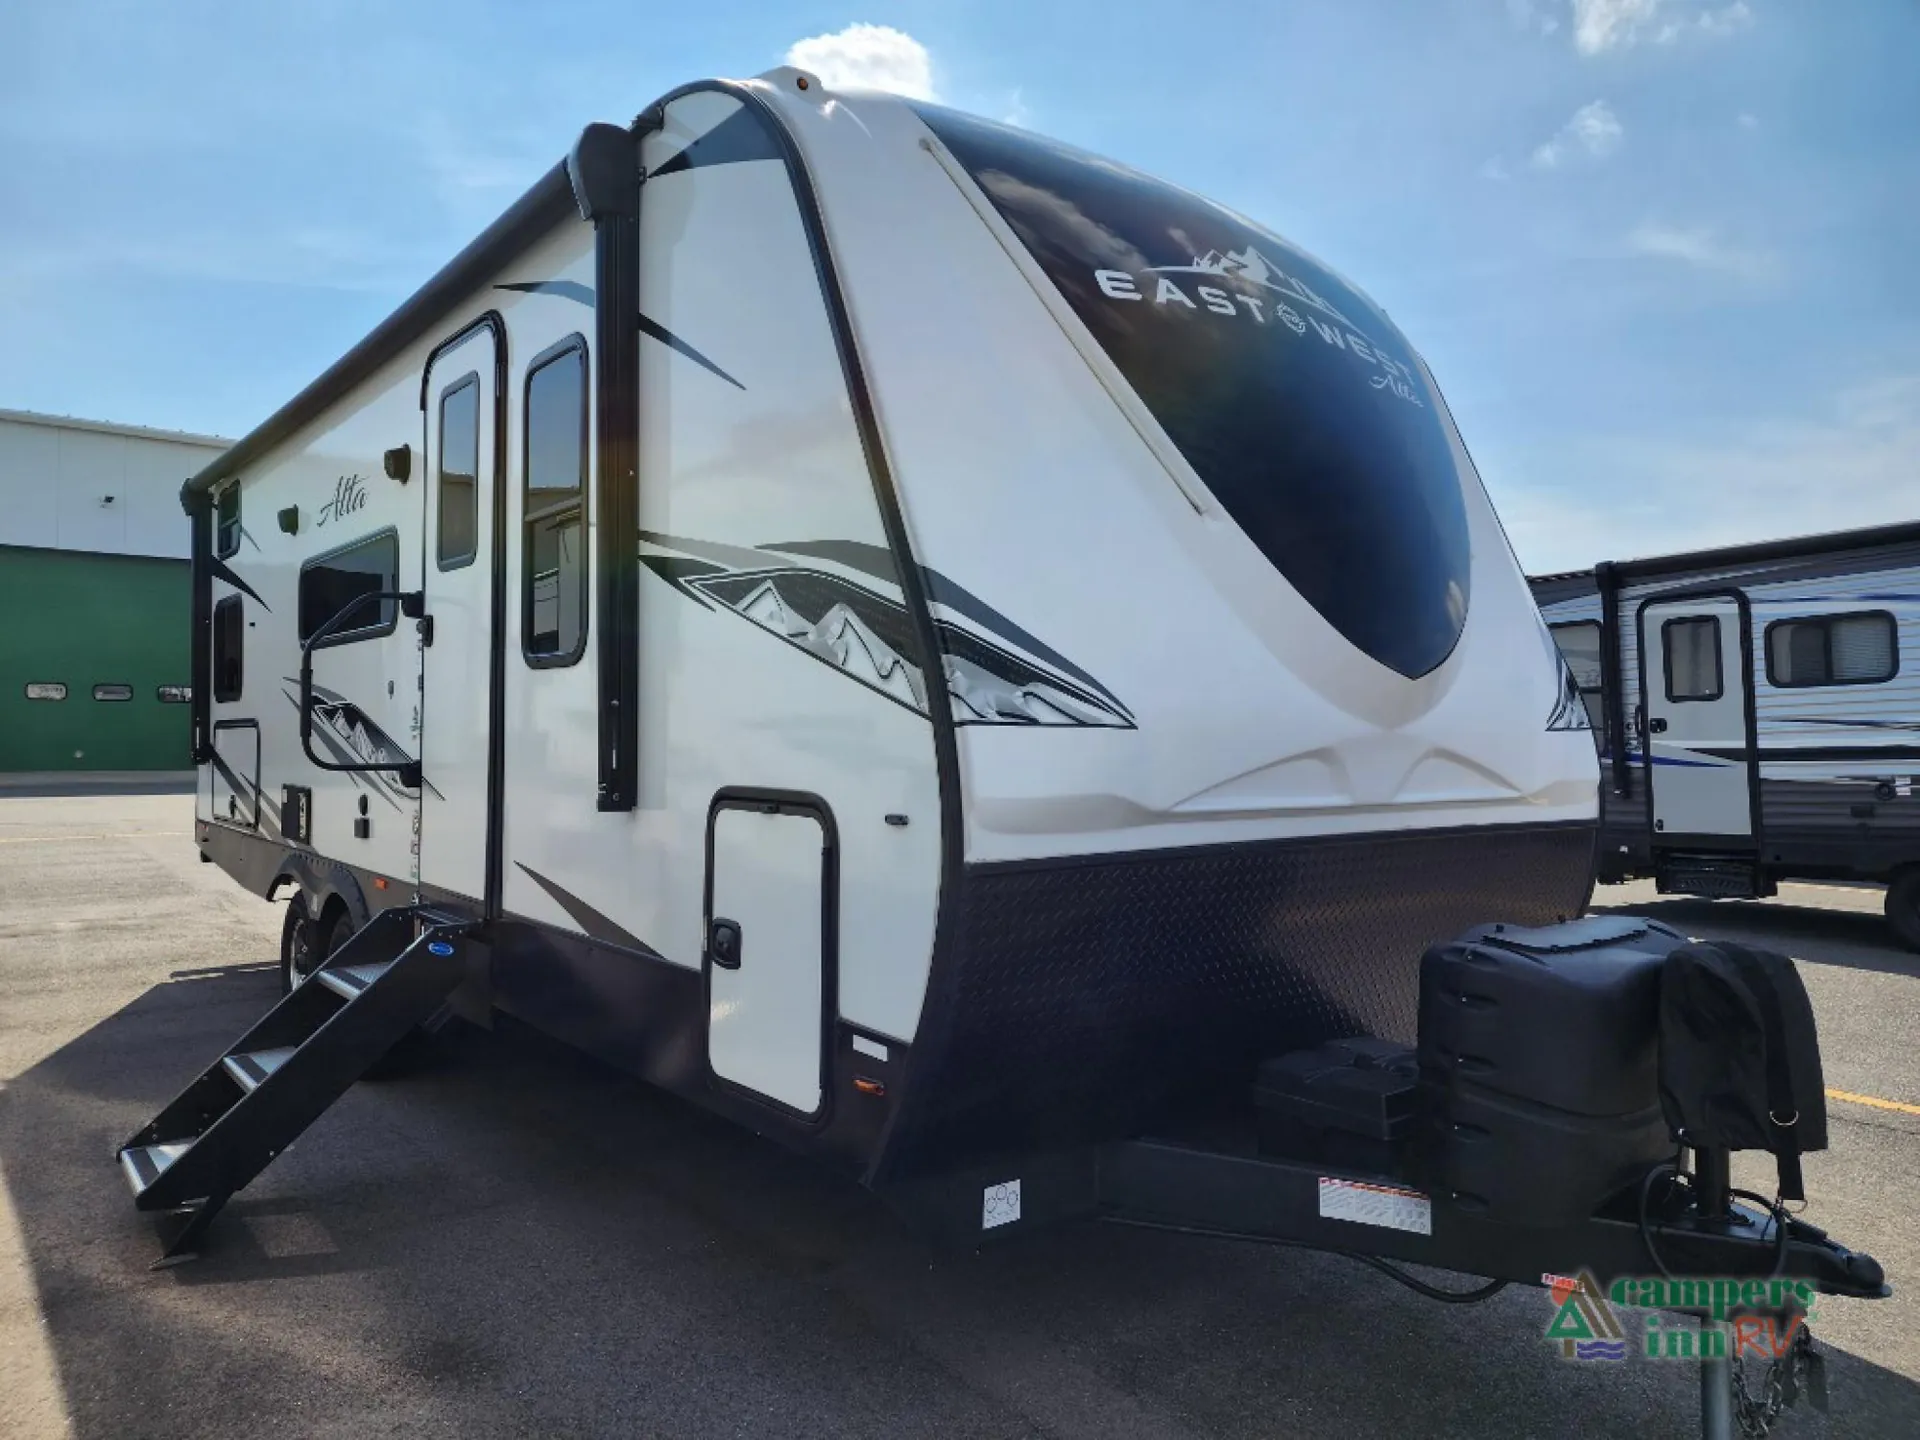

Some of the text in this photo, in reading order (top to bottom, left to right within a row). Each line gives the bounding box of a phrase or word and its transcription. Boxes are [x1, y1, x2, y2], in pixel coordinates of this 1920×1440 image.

[1094, 268, 1265, 324] EAST
[1308, 316, 1414, 386] WEST
[316, 473, 371, 527] Alta
